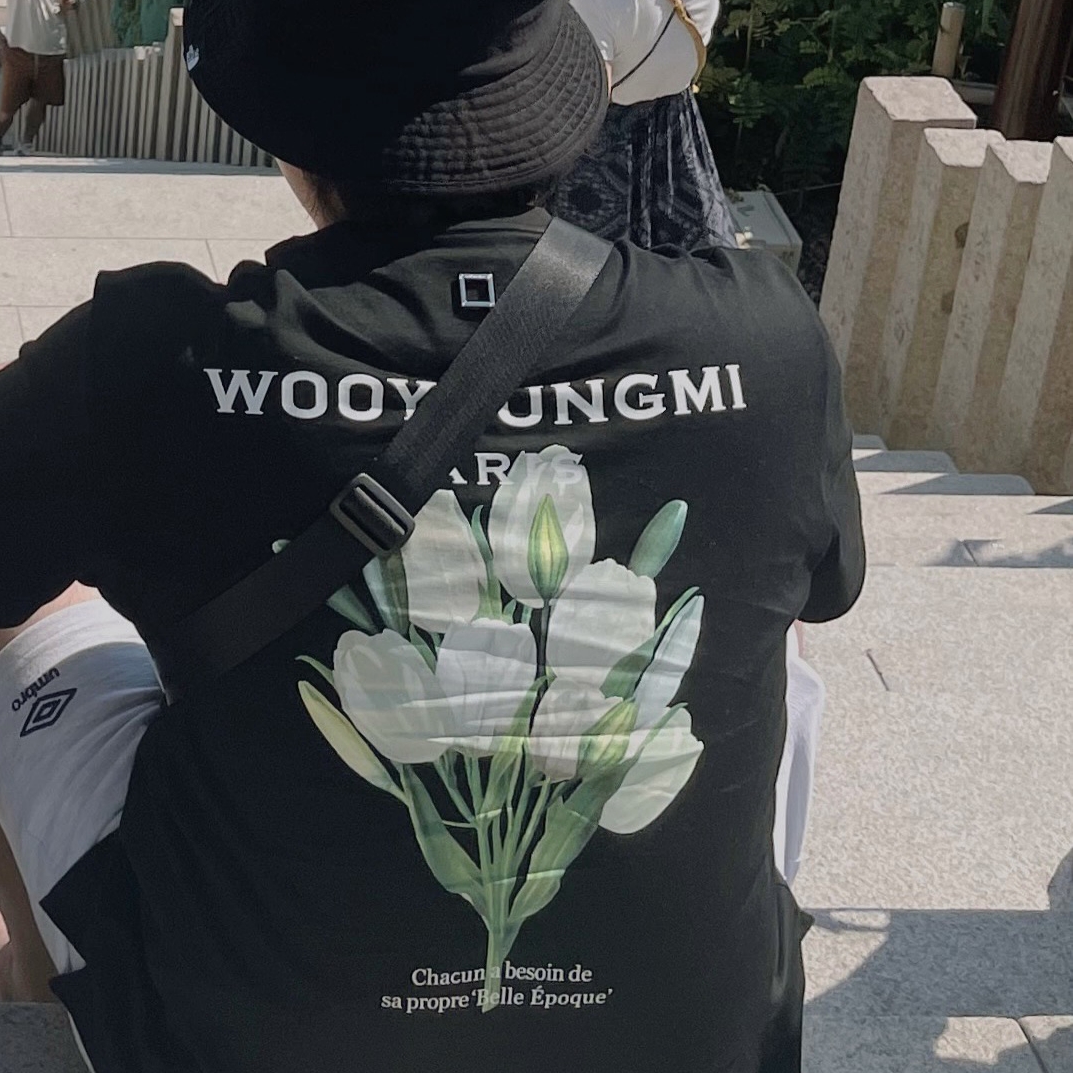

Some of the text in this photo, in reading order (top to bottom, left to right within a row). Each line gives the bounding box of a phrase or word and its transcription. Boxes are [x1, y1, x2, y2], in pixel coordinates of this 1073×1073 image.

[203, 363, 748, 429] WOOYUNGMI
[11, 667, 60, 712] umbro
[411, 961, 593, 987] Chacun a besoin de
[381, 994, 402, 1009] sa
[406, 993, 470, 1014] propre
